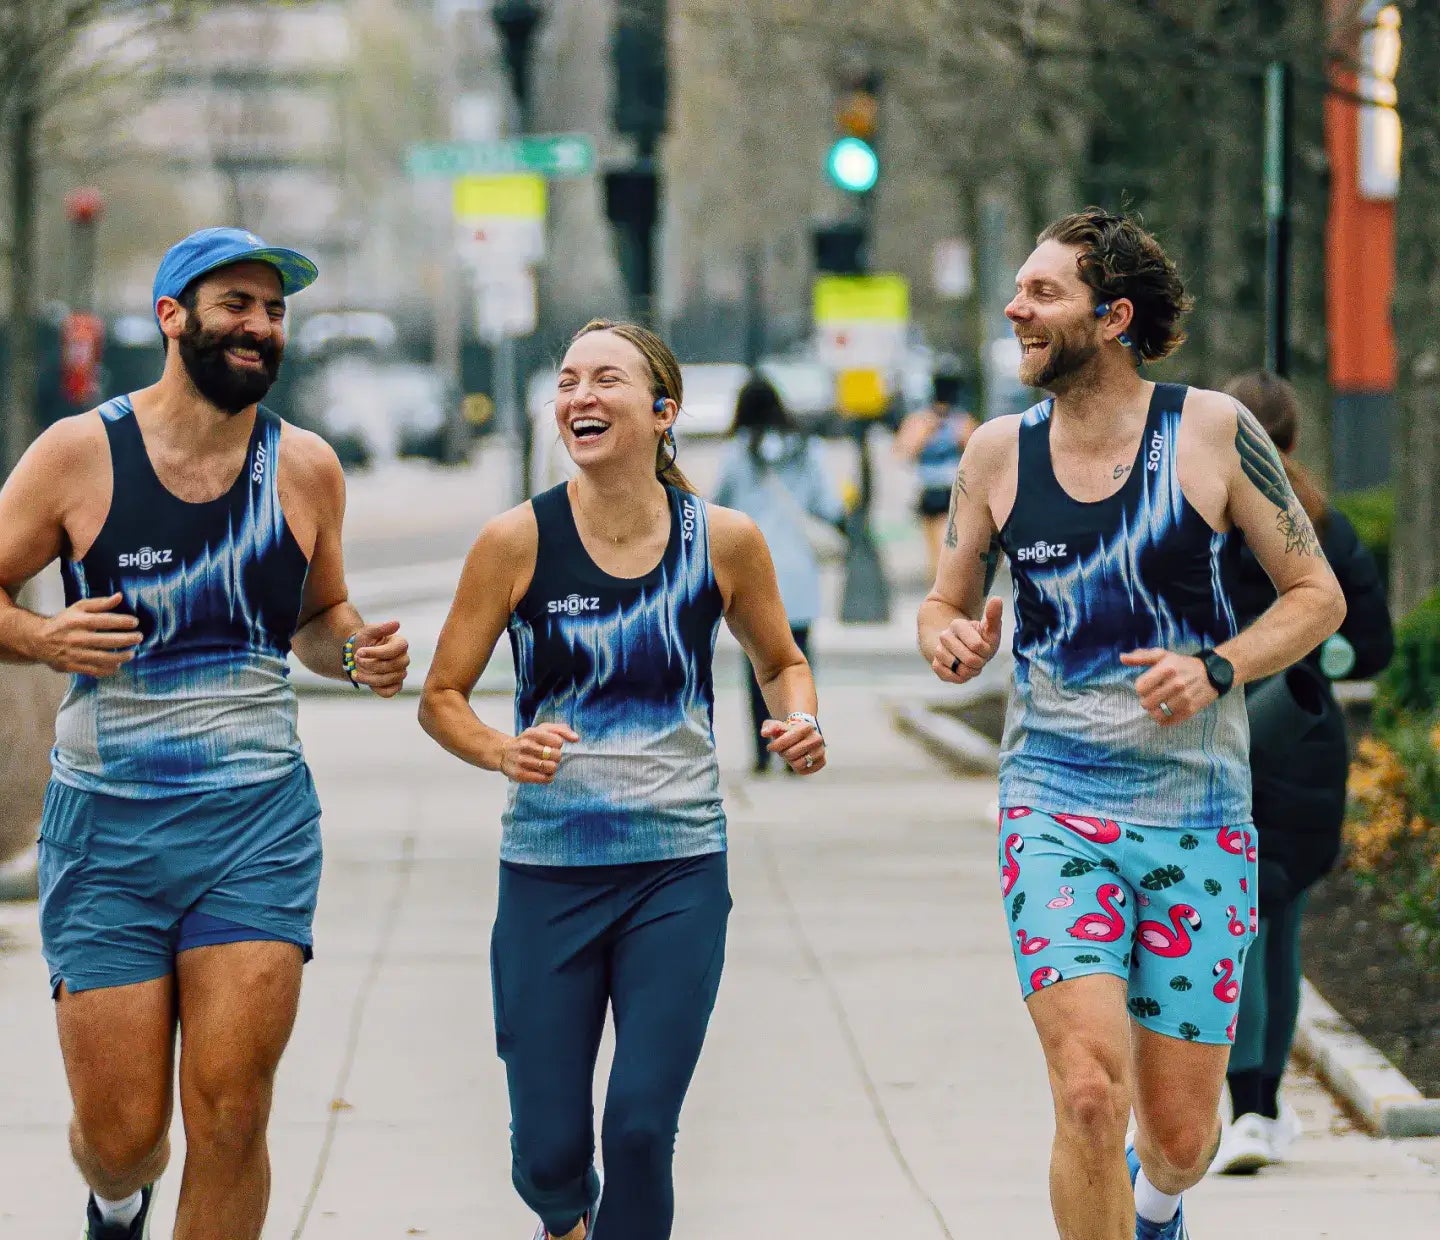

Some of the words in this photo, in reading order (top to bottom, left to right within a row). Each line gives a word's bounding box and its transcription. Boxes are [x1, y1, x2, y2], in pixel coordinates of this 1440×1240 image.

[252, 441, 267, 484] soar
[1147, 429, 1164, 472] soar
[683, 499, 695, 541] soar
[118, 547, 173, 570] SHOKZ
[1017, 541, 1067, 563] SHOKZ
[547, 594, 600, 615] SHOKZ
